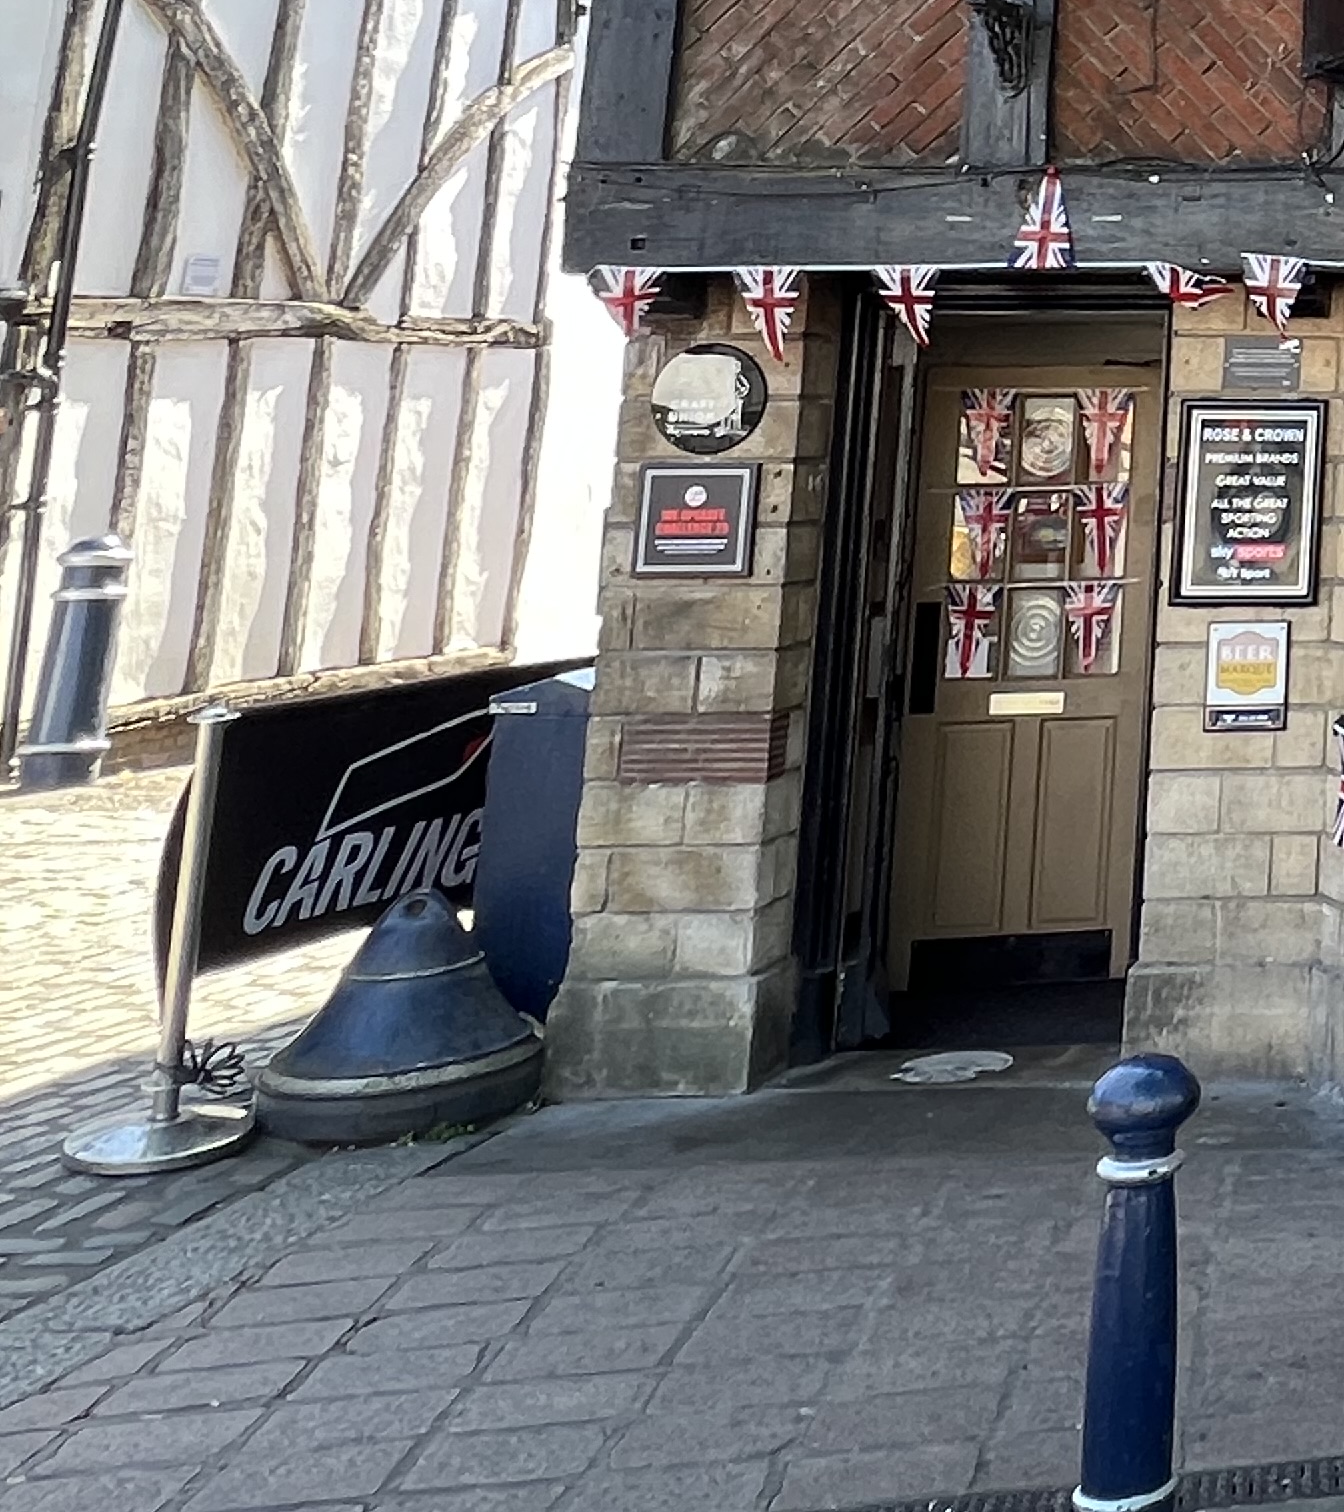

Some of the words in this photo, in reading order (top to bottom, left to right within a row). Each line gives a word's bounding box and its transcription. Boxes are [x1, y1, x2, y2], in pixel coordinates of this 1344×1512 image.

[1202, 426, 1239, 442] ROSE
[1241, 427, 1251, 442] &
[1254, 427, 1304, 442] CROWN
[1205, 452, 1254, 463] PREMIUM
[1255, 452, 1298, 464] BRANDS
[1214, 474, 1251, 487] GREAT
[1252, 474, 1286, 487] VALUE
[1210, 497, 1230, 509] ALL
[1231, 497, 1252, 509] THE
[1253, 497, 1288, 509] GREAT
[1220, 512, 1277, 524] SPORTING
[1226, 527, 1270, 538] ACTION
[1237, 546, 1286, 560] sports
[1220, 644, 1273, 660] BEER
[243, 808, 485, 936] CARLING
